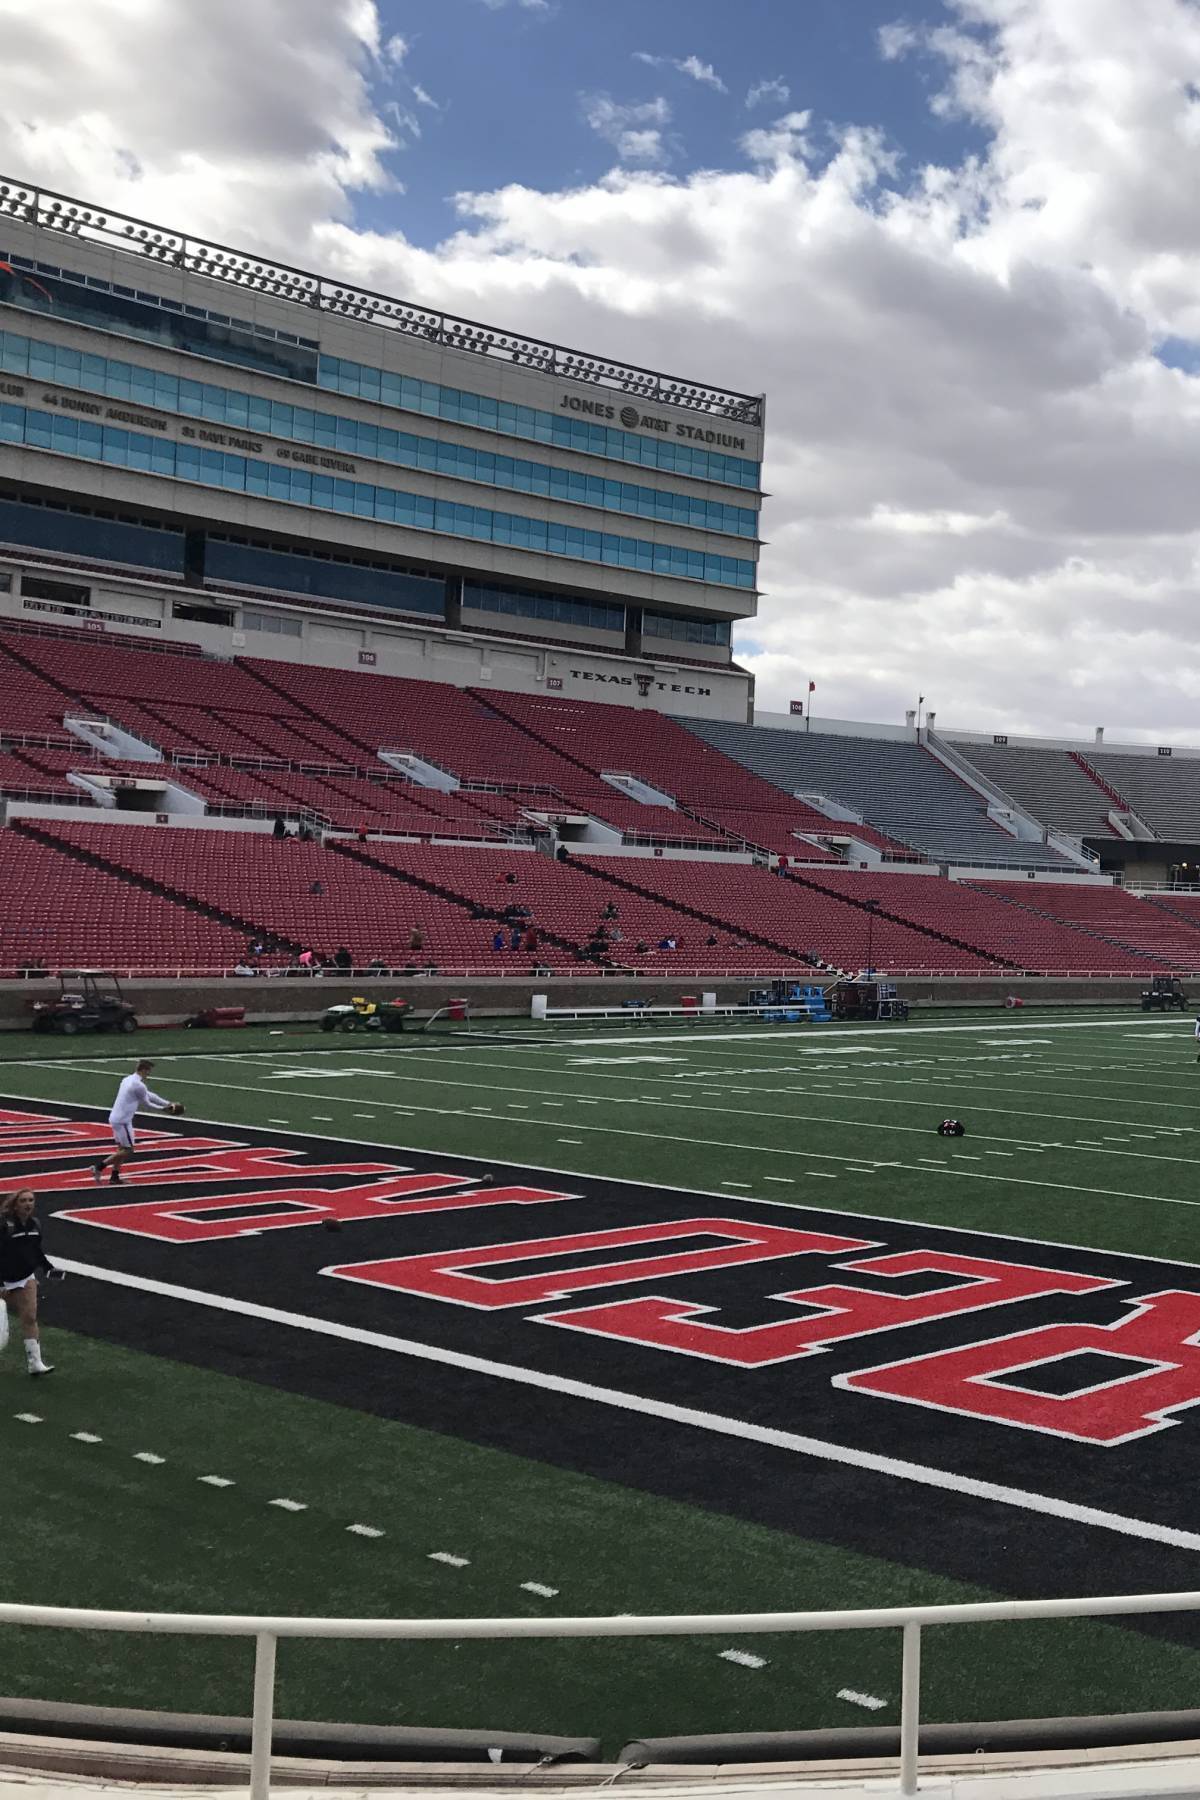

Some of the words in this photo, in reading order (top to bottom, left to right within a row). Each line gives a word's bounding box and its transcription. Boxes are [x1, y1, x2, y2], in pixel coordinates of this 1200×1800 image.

[105, 408, 167, 431] ANDERSON
[560, 395, 615, 419] JONES
[640, 415, 672, 433] AT&T
[676, 424, 745, 450] STADIUM
[199, 429, 226, 445] DAVE
[228, 437, 264, 454] PARKS
[292, 450, 319, 466] GABE
[320, 457, 356, 474] RIVERA
[570, 670, 632, 686] TEXAS
[656, 681, 711, 696] TECH
